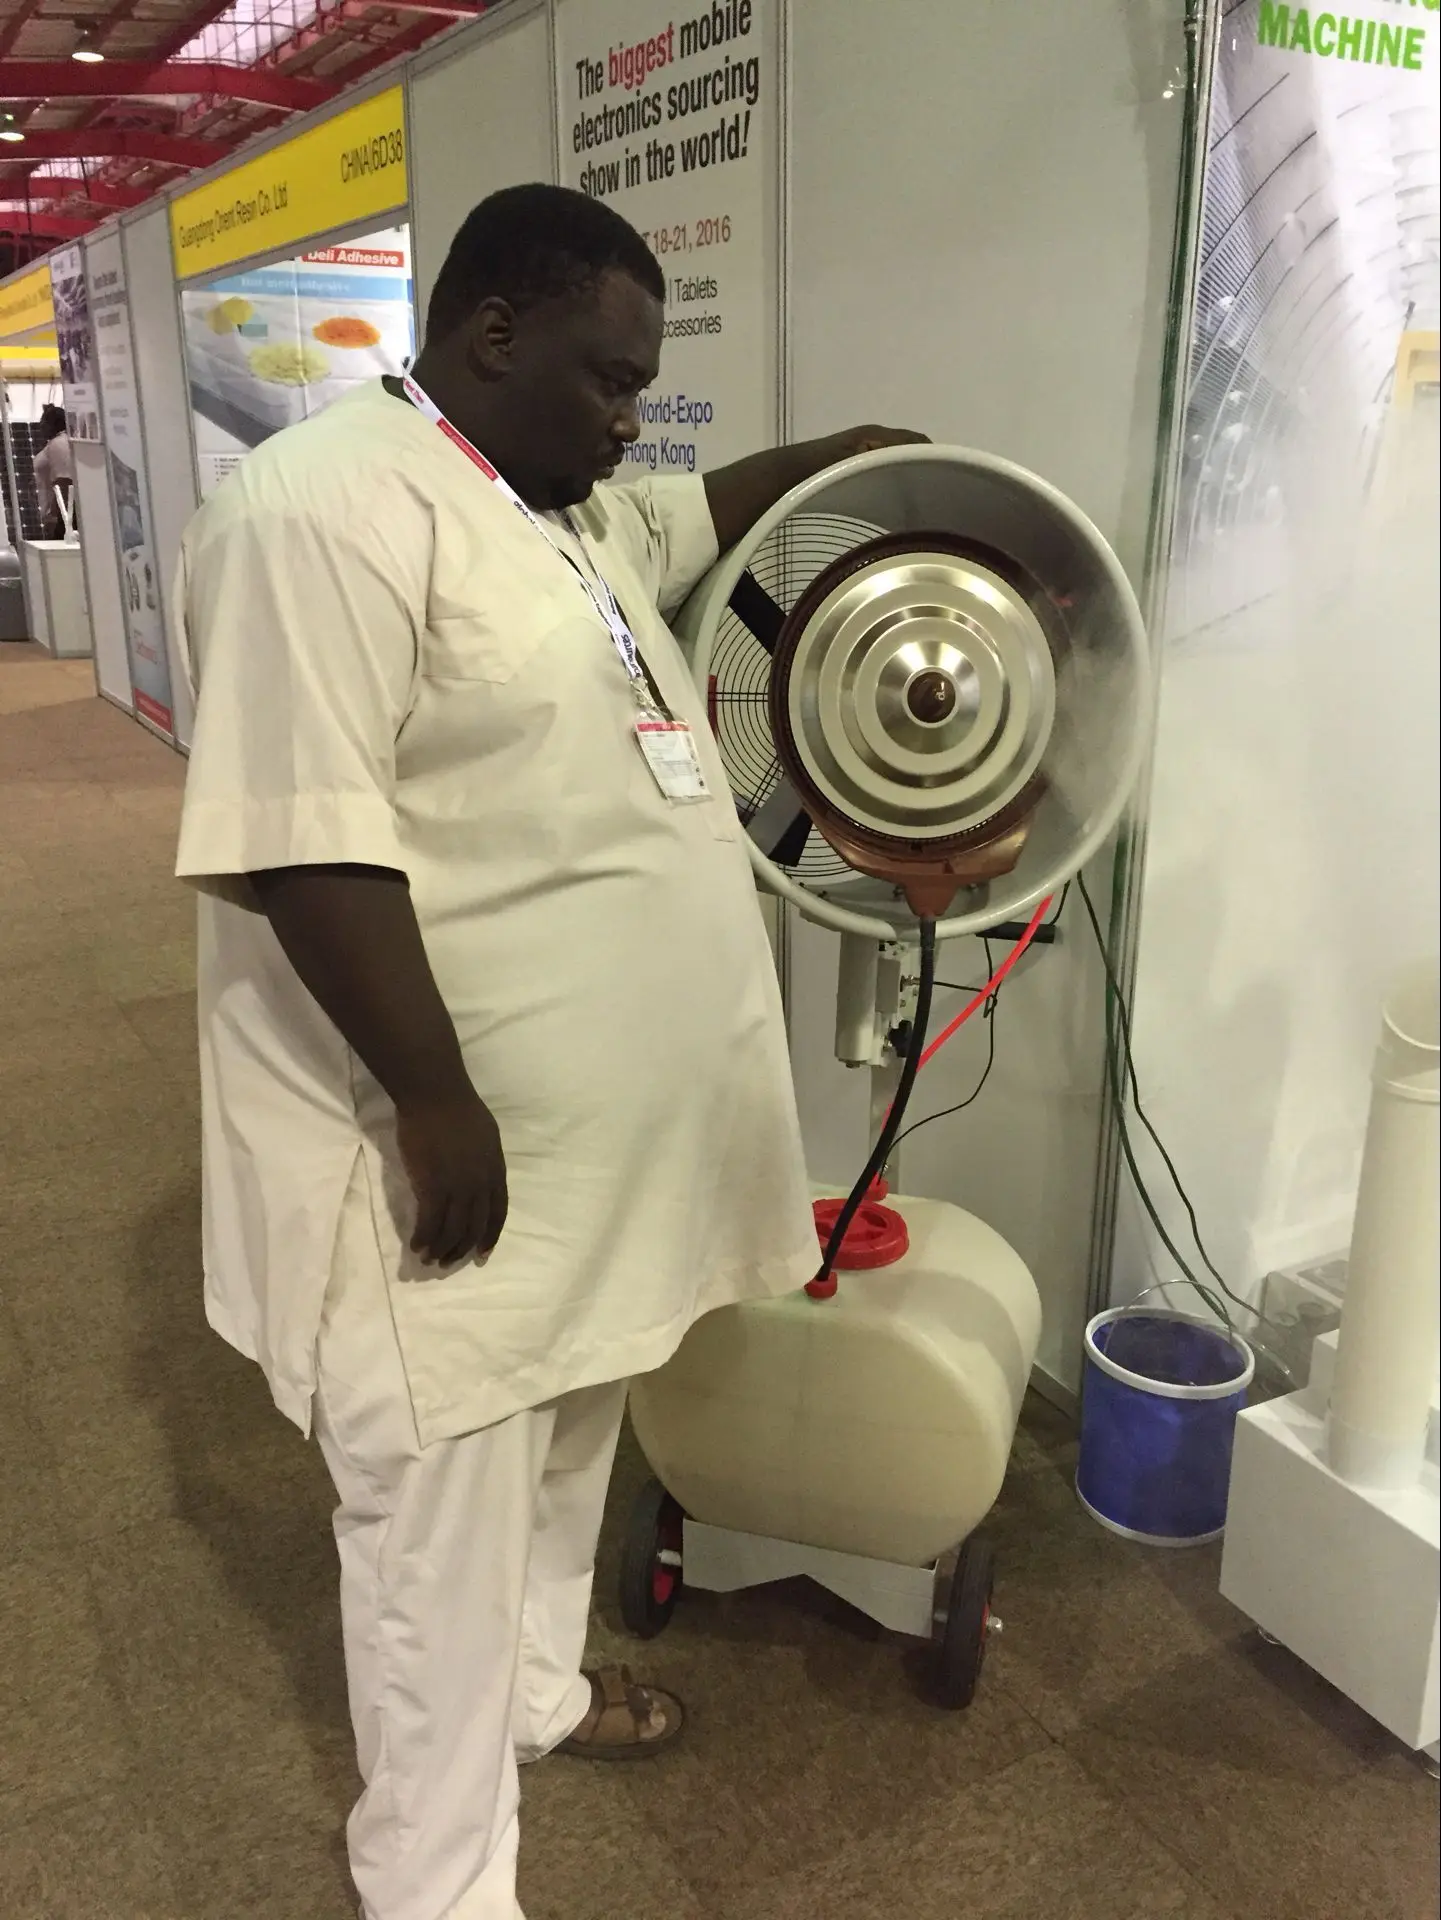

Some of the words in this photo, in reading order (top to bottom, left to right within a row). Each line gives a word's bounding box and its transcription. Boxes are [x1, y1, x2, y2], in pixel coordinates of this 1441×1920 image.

[575, 57, 604, 100] The
[608, 21, 674, 90] biggest
[680, 0, 752, 59] mobile
[1258, 0, 1426, 70] MACHINE
[573, 89, 662, 154] electronics
[667, 55, 759, 121] sourcing
[580, 160, 620, 198] show
[625, 148, 641, 189] in
[646, 139, 675, 182] the
[681, 110, 751, 173] world!
[653, 223, 693, 254] 18-21,
[696, 214, 731, 248] 2016
[337, 249, 399, 265] Adhesive
[674, 275, 718, 303] Tablets
[663, 309, 722, 339] ccessories
[625, 441, 657, 471] Hong
[660, 436, 696, 472] Kong
